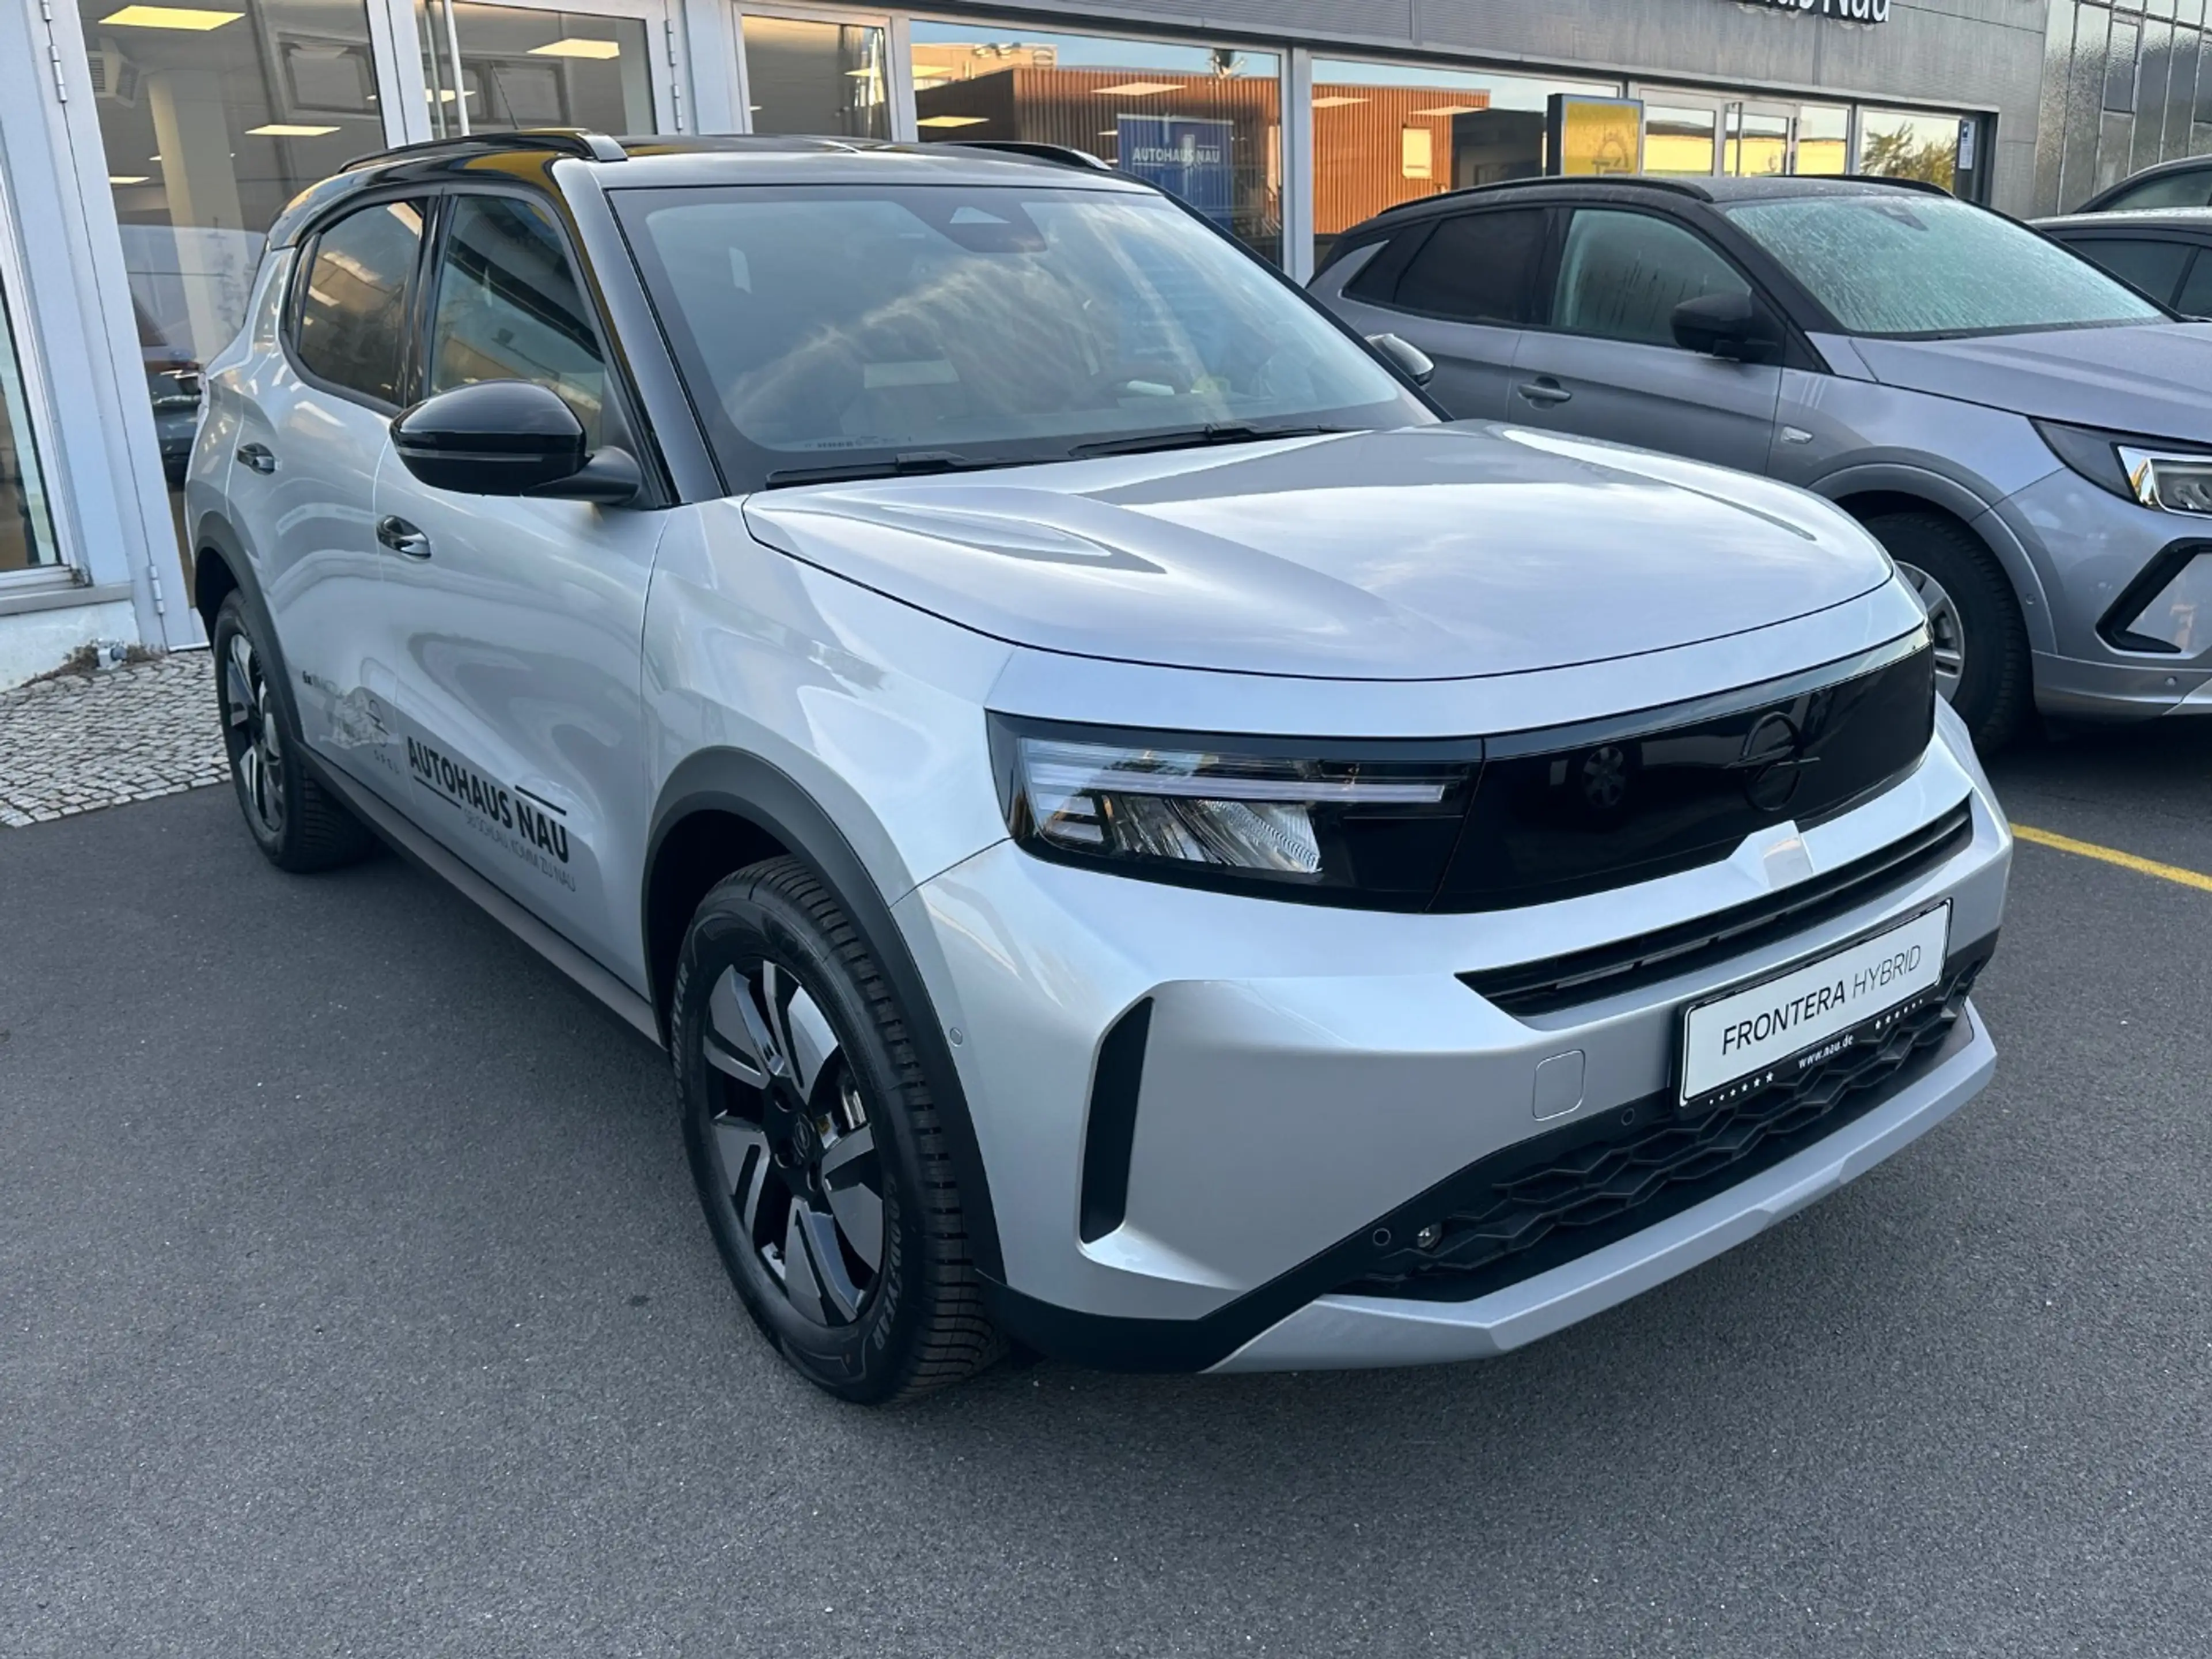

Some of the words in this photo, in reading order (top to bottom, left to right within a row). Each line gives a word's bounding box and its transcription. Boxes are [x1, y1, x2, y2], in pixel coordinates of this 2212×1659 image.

[1132, 147, 1194, 162] AUTOHAUS
[1196, 150, 1220, 163] NAU
[407, 735, 513, 830] AUTOHAUS
[515, 799, 569, 863] NAU
[1721, 980, 1846, 1056] FRONTERA
[1852, 945, 1922, 999] HYBRID
[1798, 1033, 1854, 1069] www.nau.de
[872, 1172, 903, 1350] GOODYEAR
